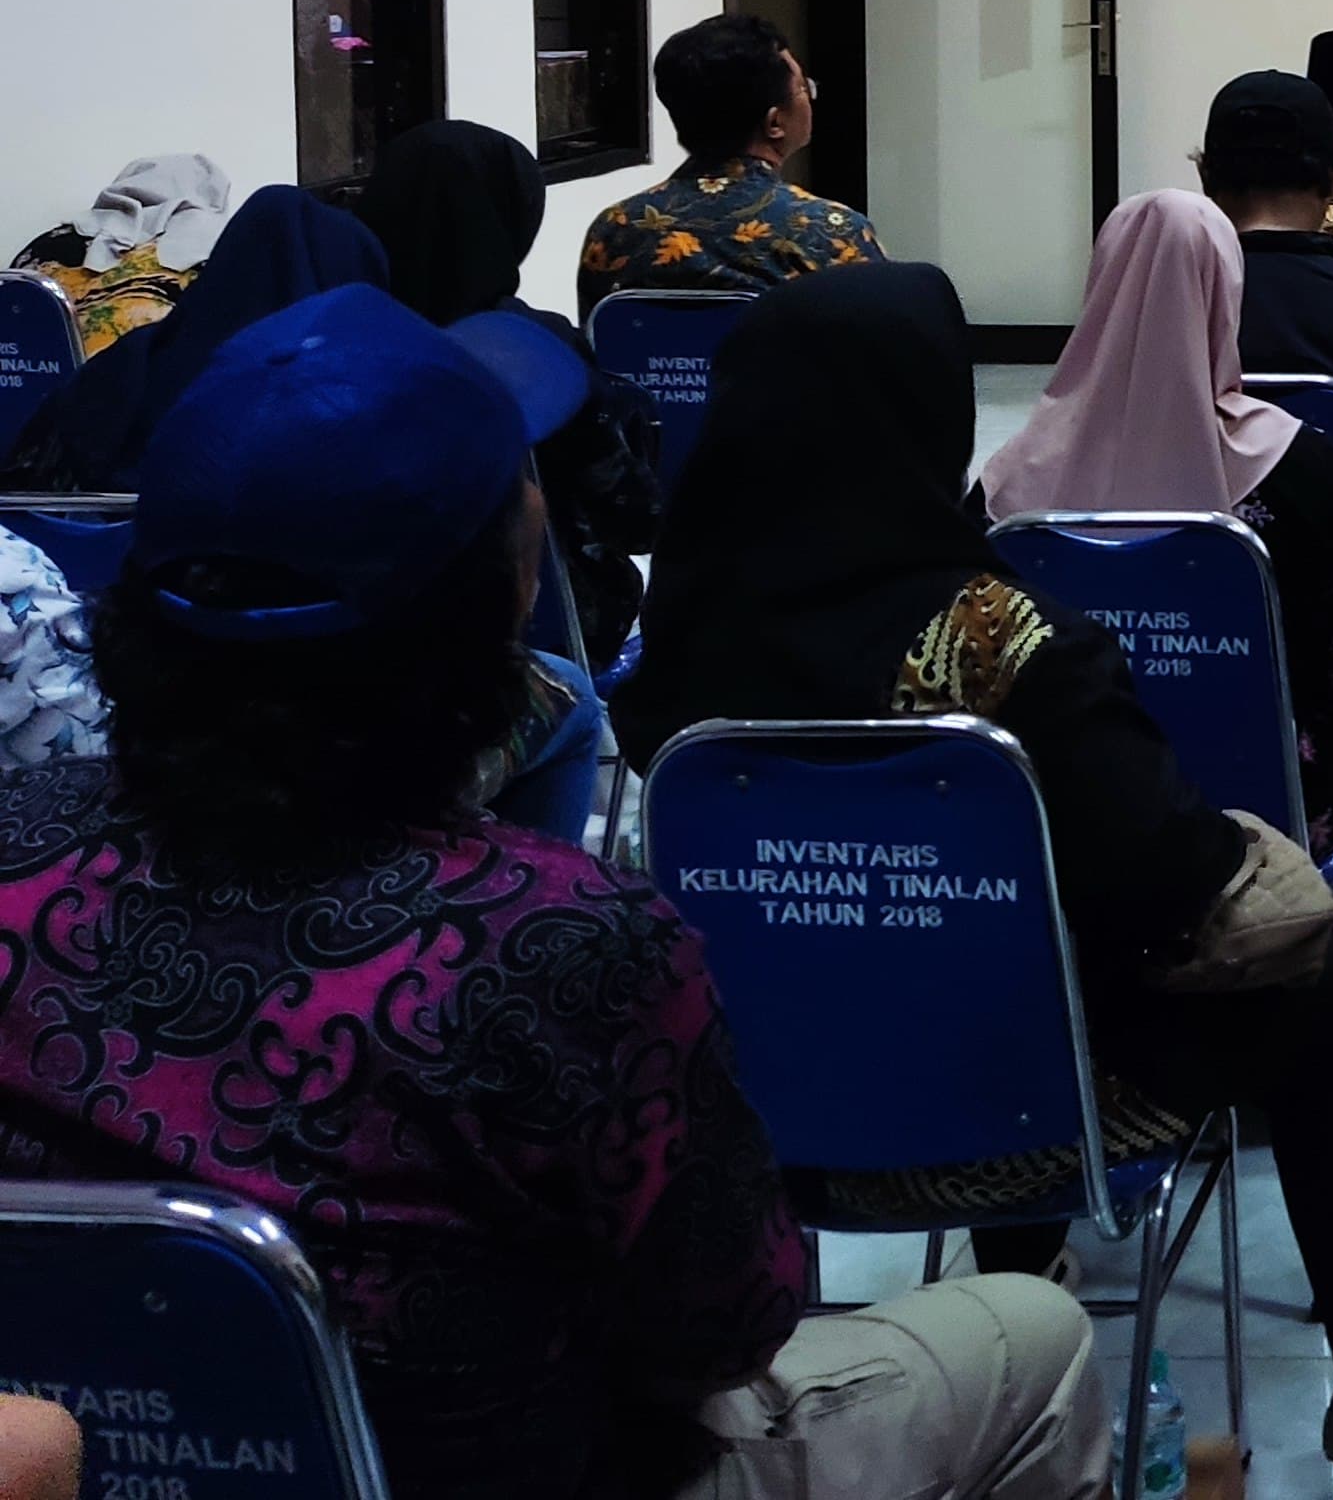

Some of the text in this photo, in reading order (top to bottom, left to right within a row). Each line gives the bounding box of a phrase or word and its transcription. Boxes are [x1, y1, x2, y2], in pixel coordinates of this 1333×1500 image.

[0, 358, 60, 375] INALAN
[648, 357, 710, 371] INVENT
[0, 375, 23, 388] 018
[1147, 634, 1249, 656] TINALAN
[1144, 658, 1192, 676] 2018
[756, 839, 938, 868] INVENTARIS
[679, 867, 1017, 902] KELURAHAN TINALAN
[759, 901, 943, 928] TAHUN 2018
[97, 1429, 296, 1474] TINALAN
[100, 1471, 190, 1500] 2018
